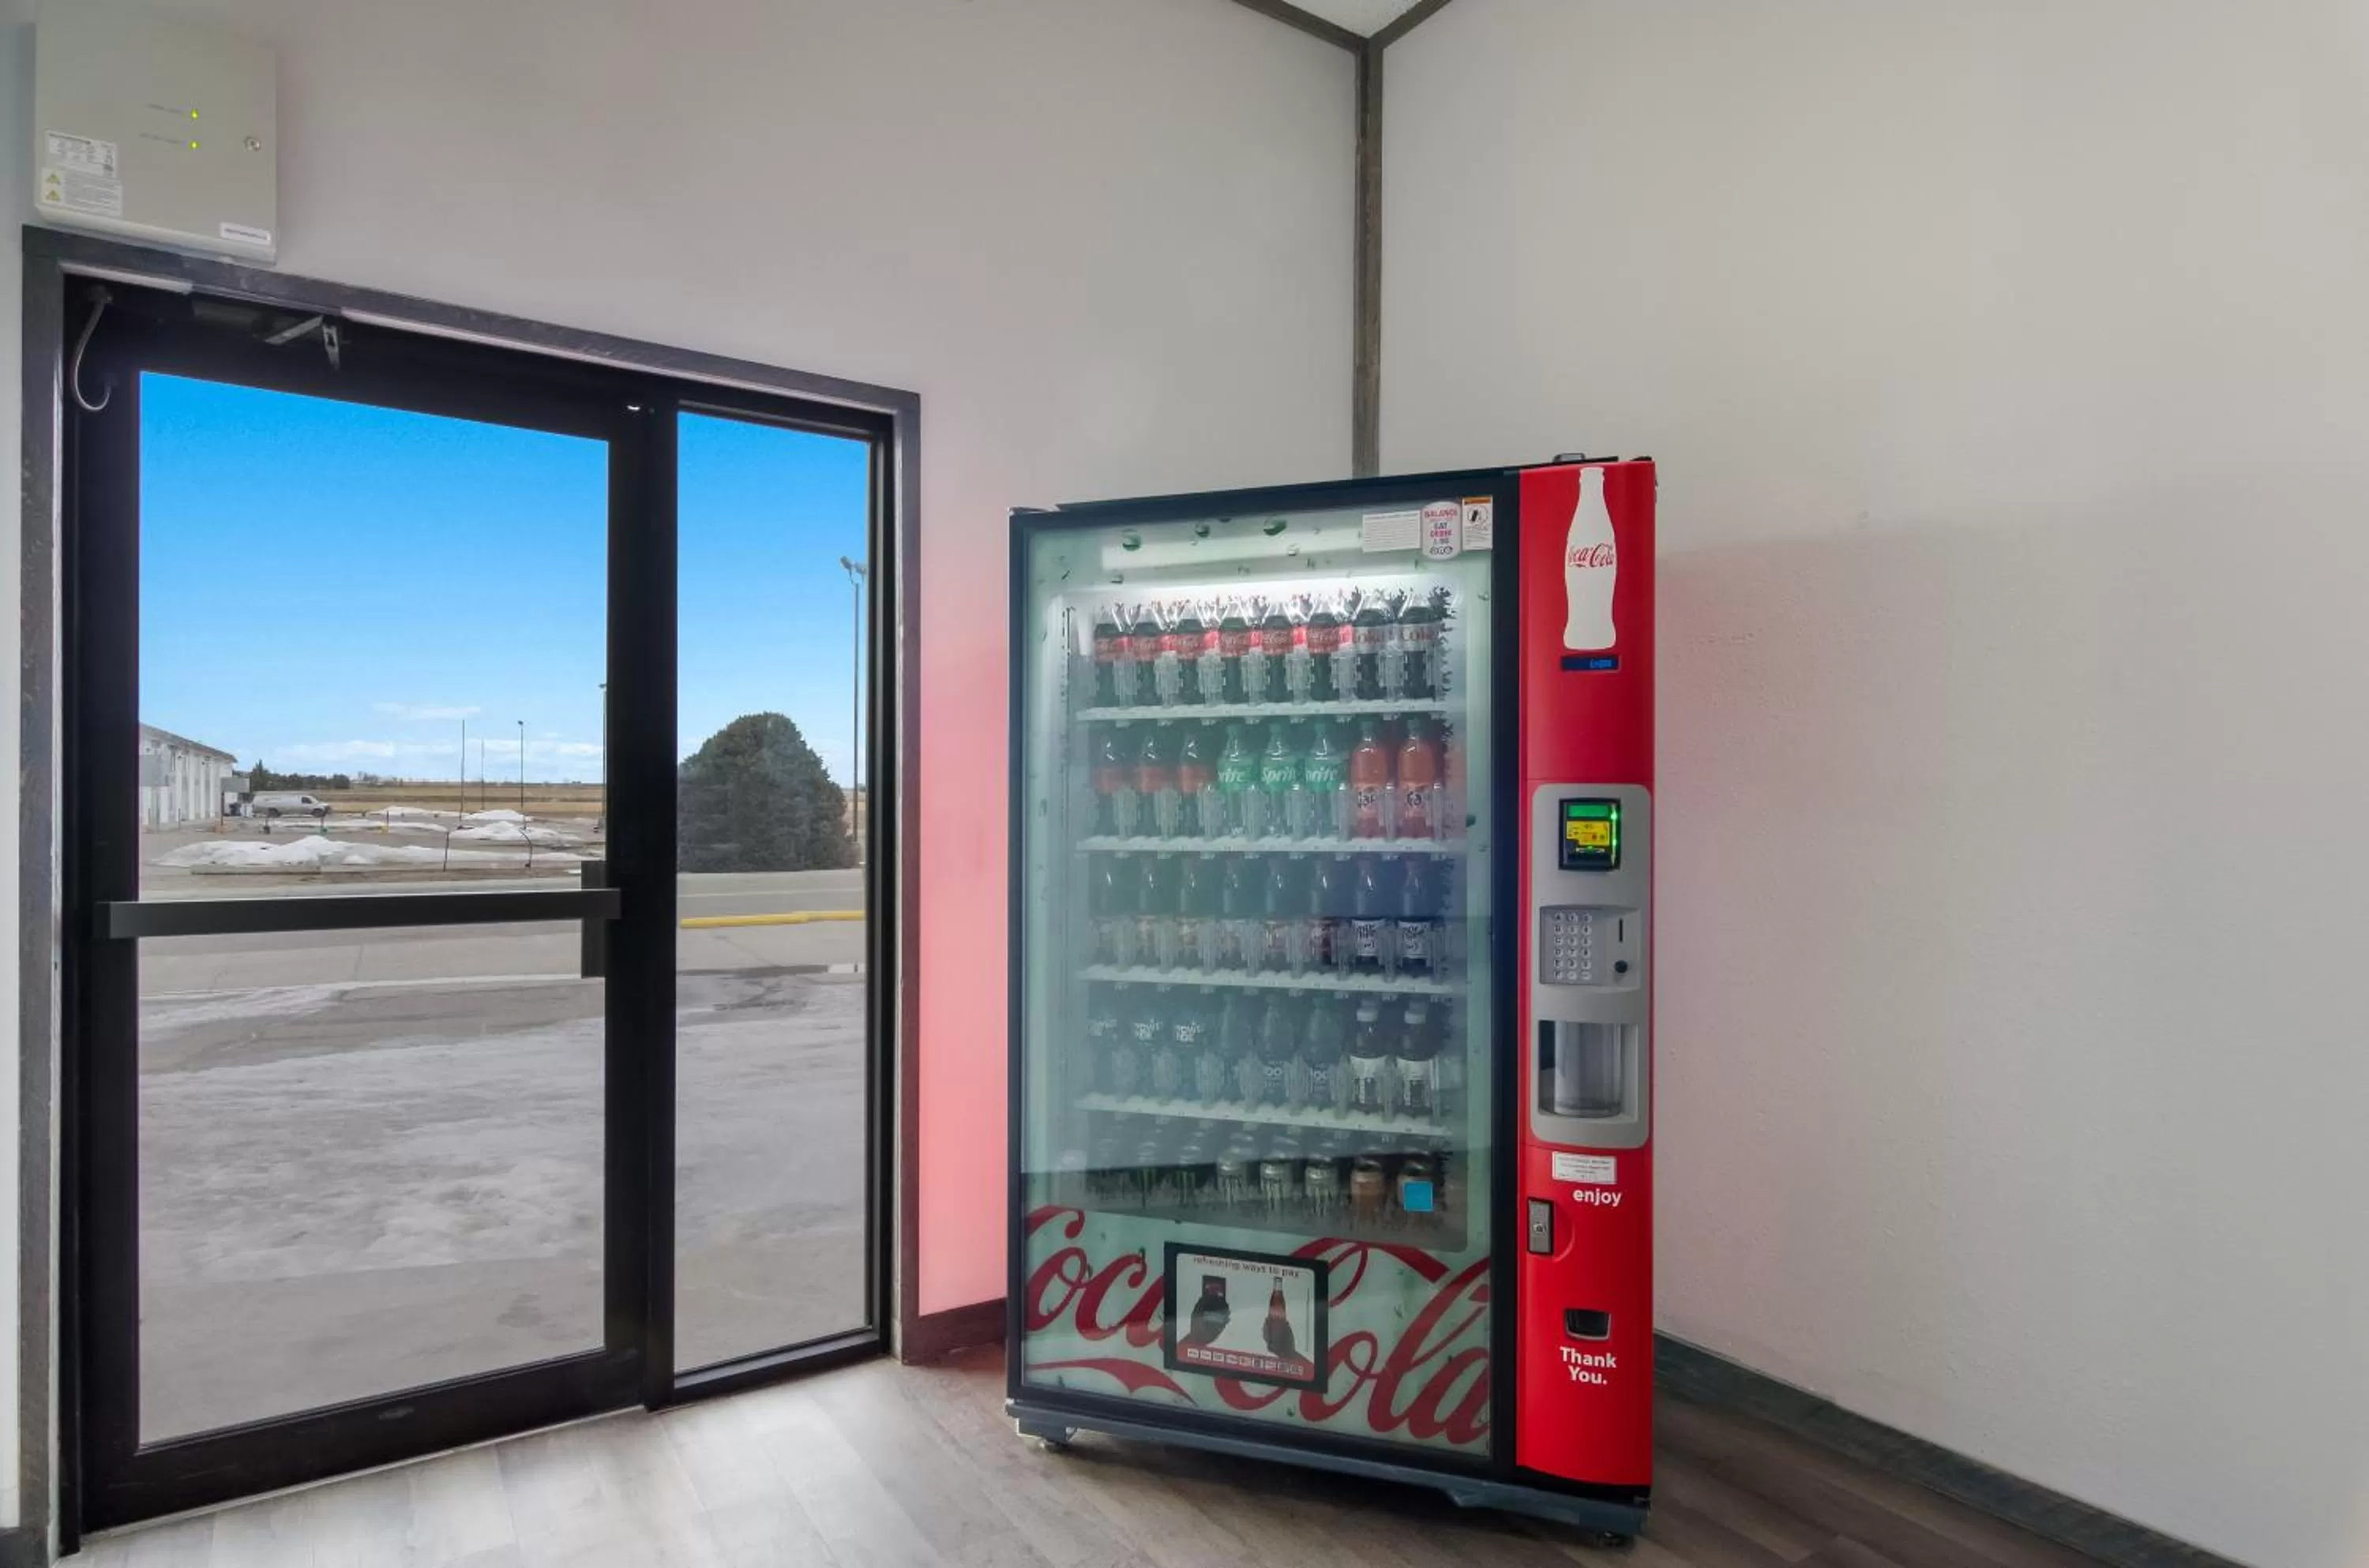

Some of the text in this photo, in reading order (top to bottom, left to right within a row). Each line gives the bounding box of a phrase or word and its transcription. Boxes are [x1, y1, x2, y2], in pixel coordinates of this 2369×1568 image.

[1572, 1188, 1622, 1207] enjoy
[1560, 1346, 1617, 1369] Thank
[1568, 1366, 1608, 1386] You.
